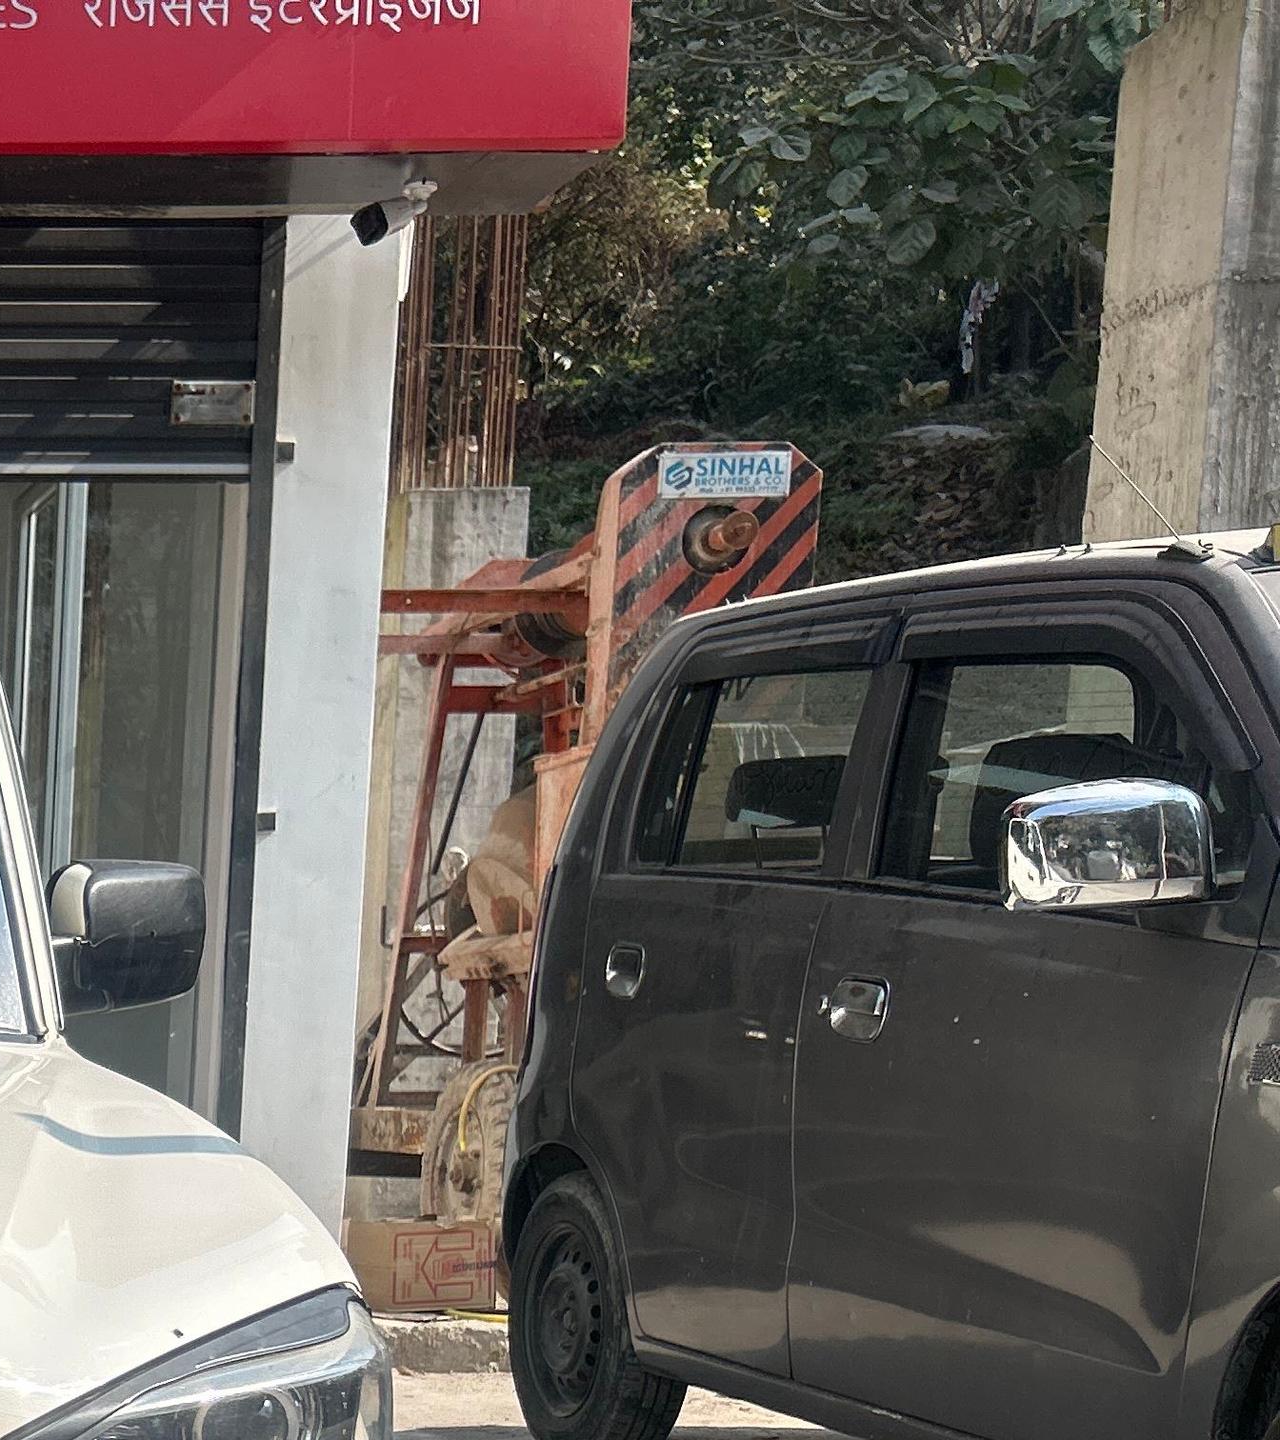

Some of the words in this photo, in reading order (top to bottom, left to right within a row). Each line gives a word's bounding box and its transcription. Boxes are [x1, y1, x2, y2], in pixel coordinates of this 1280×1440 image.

[696, 457, 784, 476] SINHAL
[695, 476, 751, 487] BROTHERS
[753, 477, 761, 486] &
